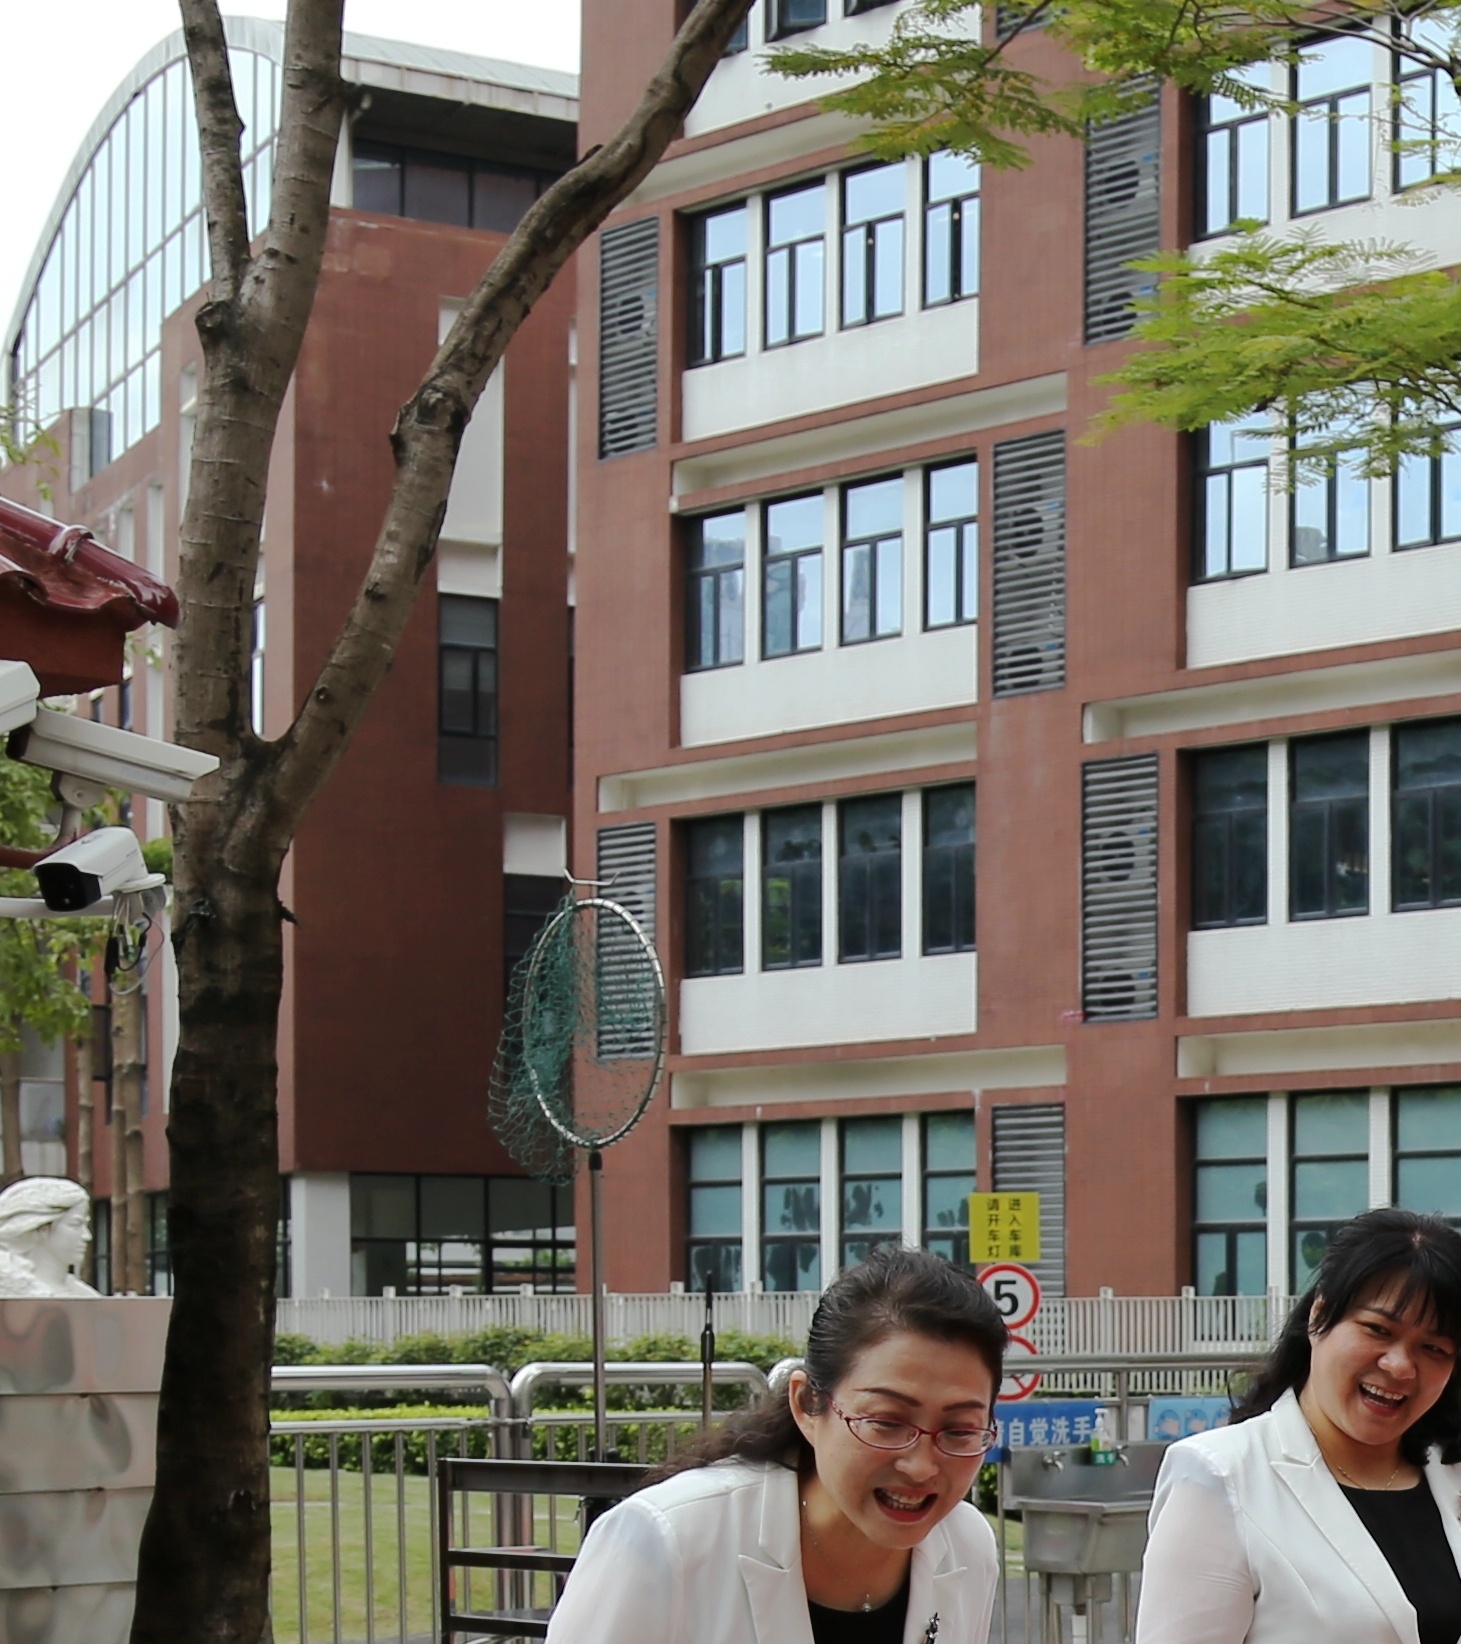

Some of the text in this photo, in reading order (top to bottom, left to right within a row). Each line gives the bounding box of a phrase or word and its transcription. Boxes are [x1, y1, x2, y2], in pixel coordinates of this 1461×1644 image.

[987, 1198, 1000, 1258] 请开车灯
[1008, 1197, 1022, 1258] 进入车库
[994, 1280, 1019, 1316] 5
